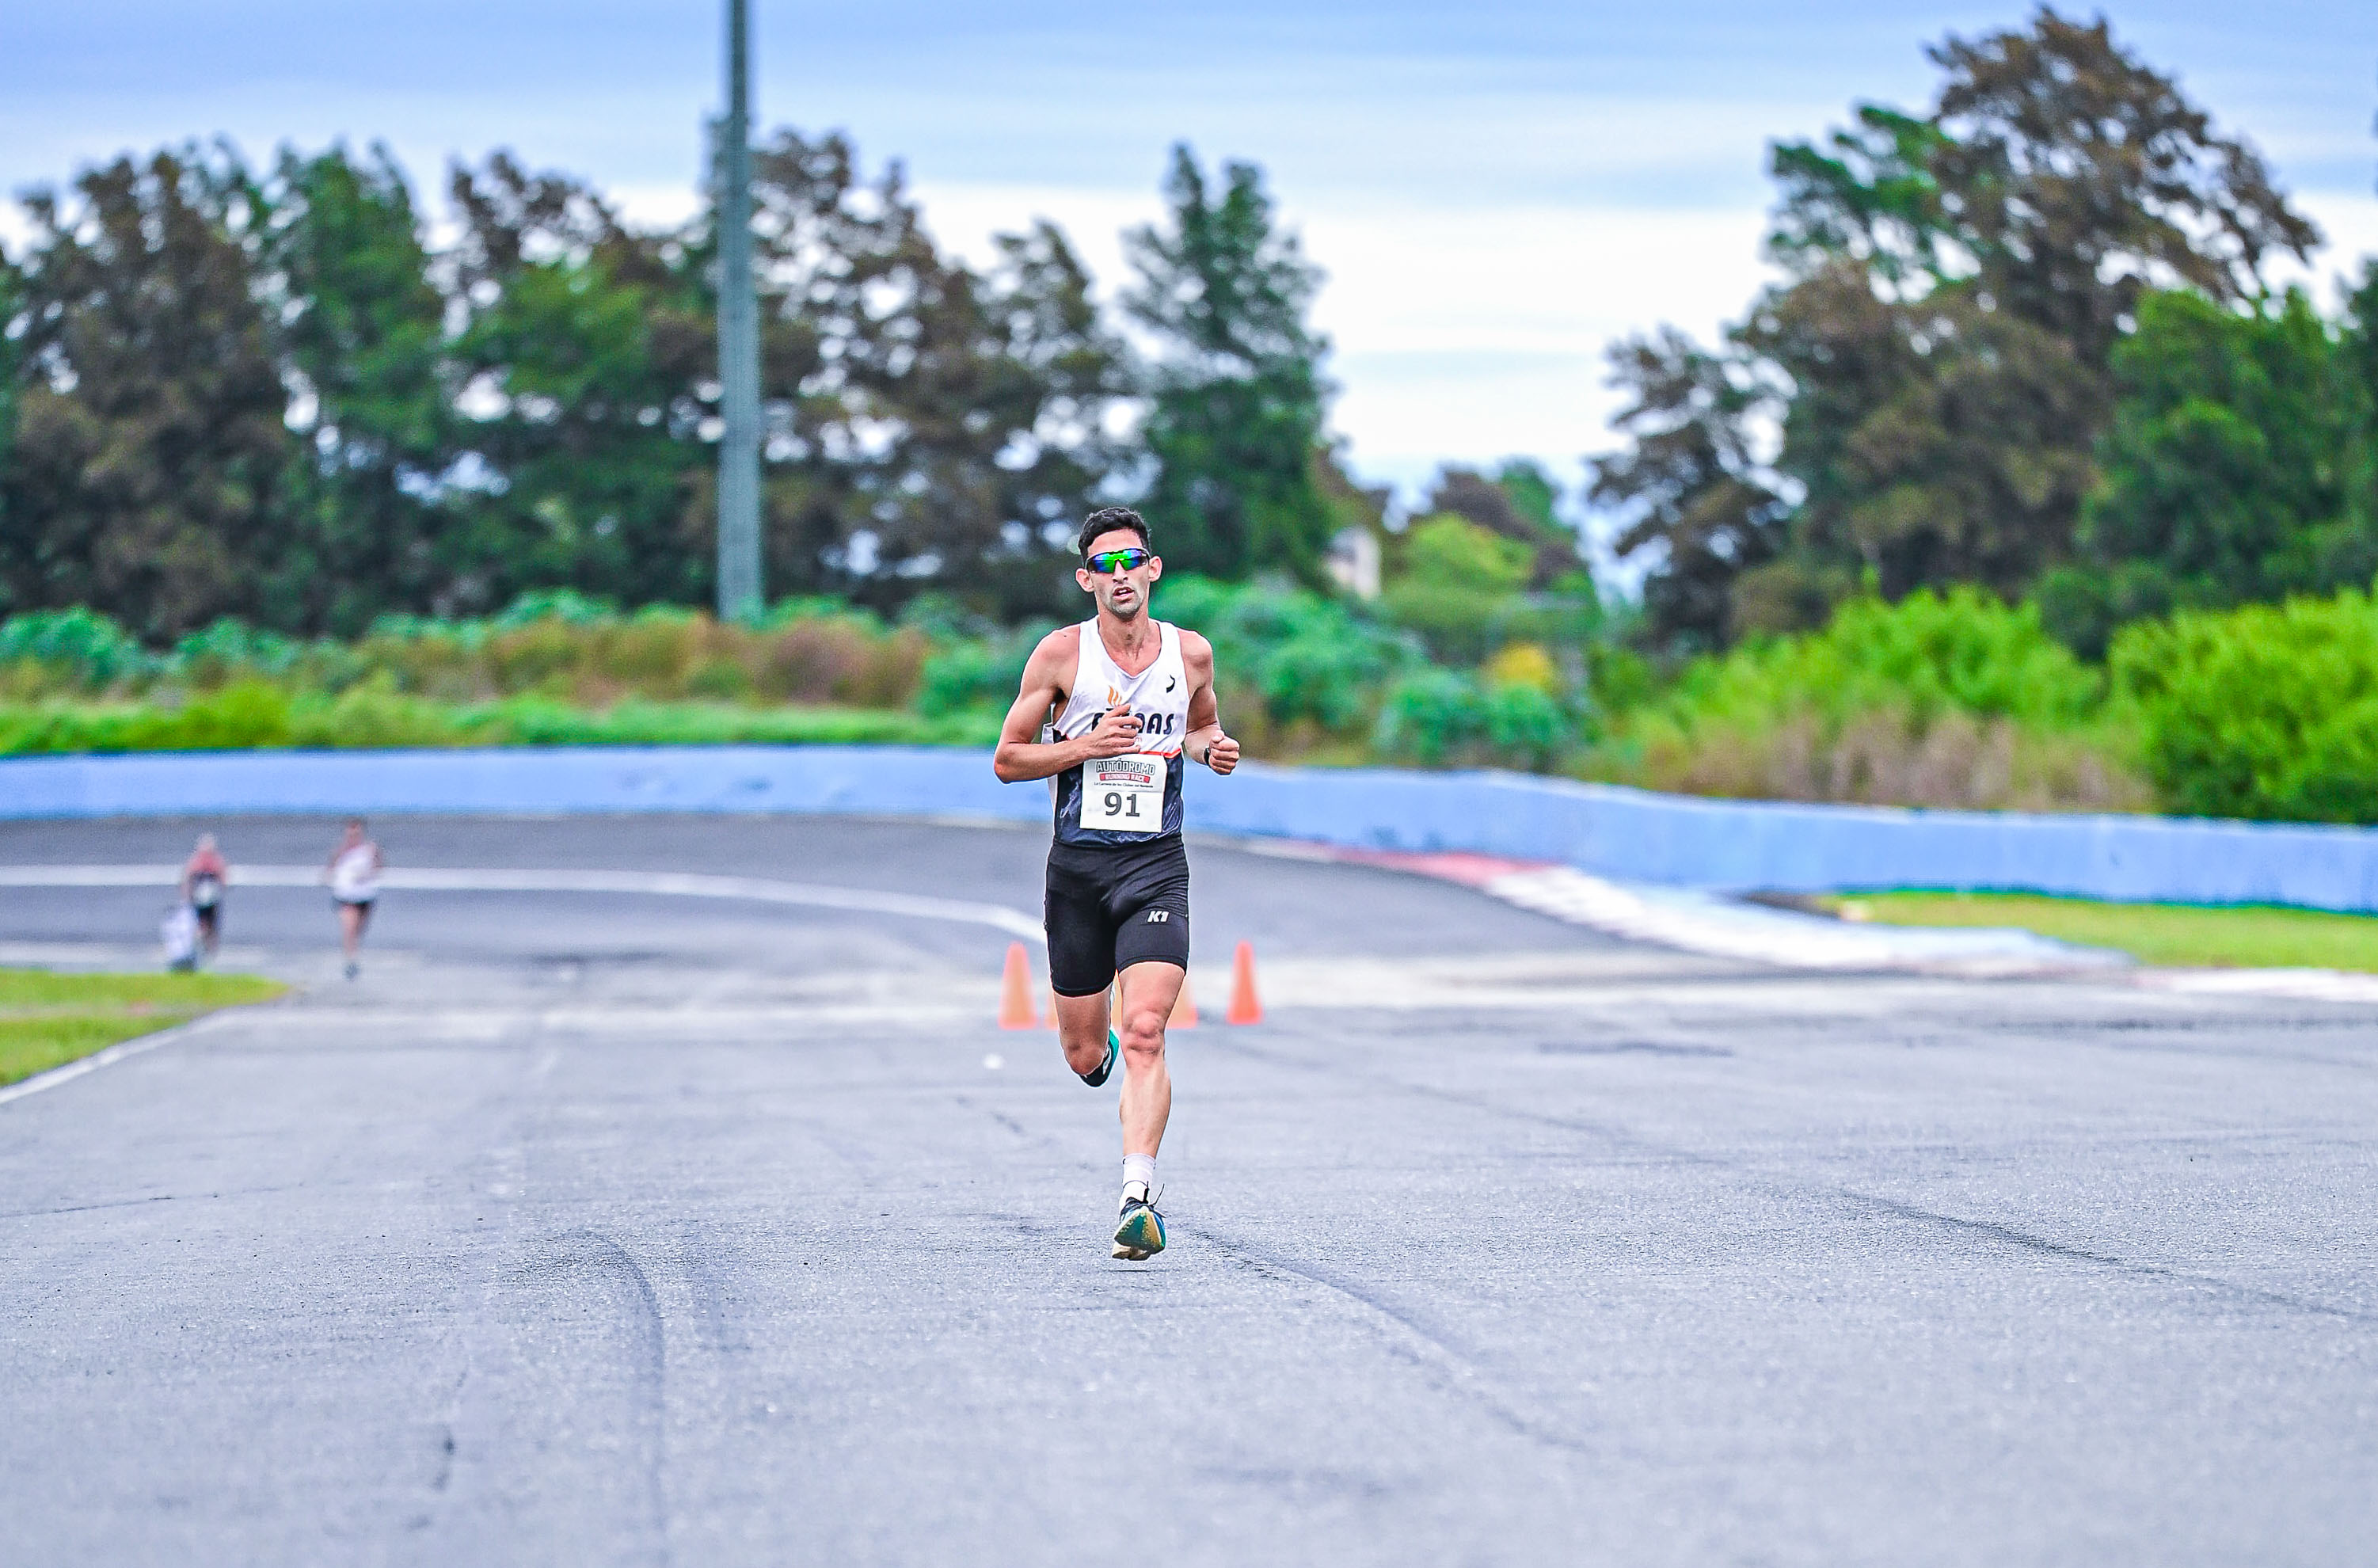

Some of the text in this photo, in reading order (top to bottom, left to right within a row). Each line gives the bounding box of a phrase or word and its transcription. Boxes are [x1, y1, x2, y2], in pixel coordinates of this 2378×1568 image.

[1096, 758, 1155, 775] AUTÓDROMO
[1104, 792, 1140, 817] 91
[1147, 911, 1170, 923] K1
